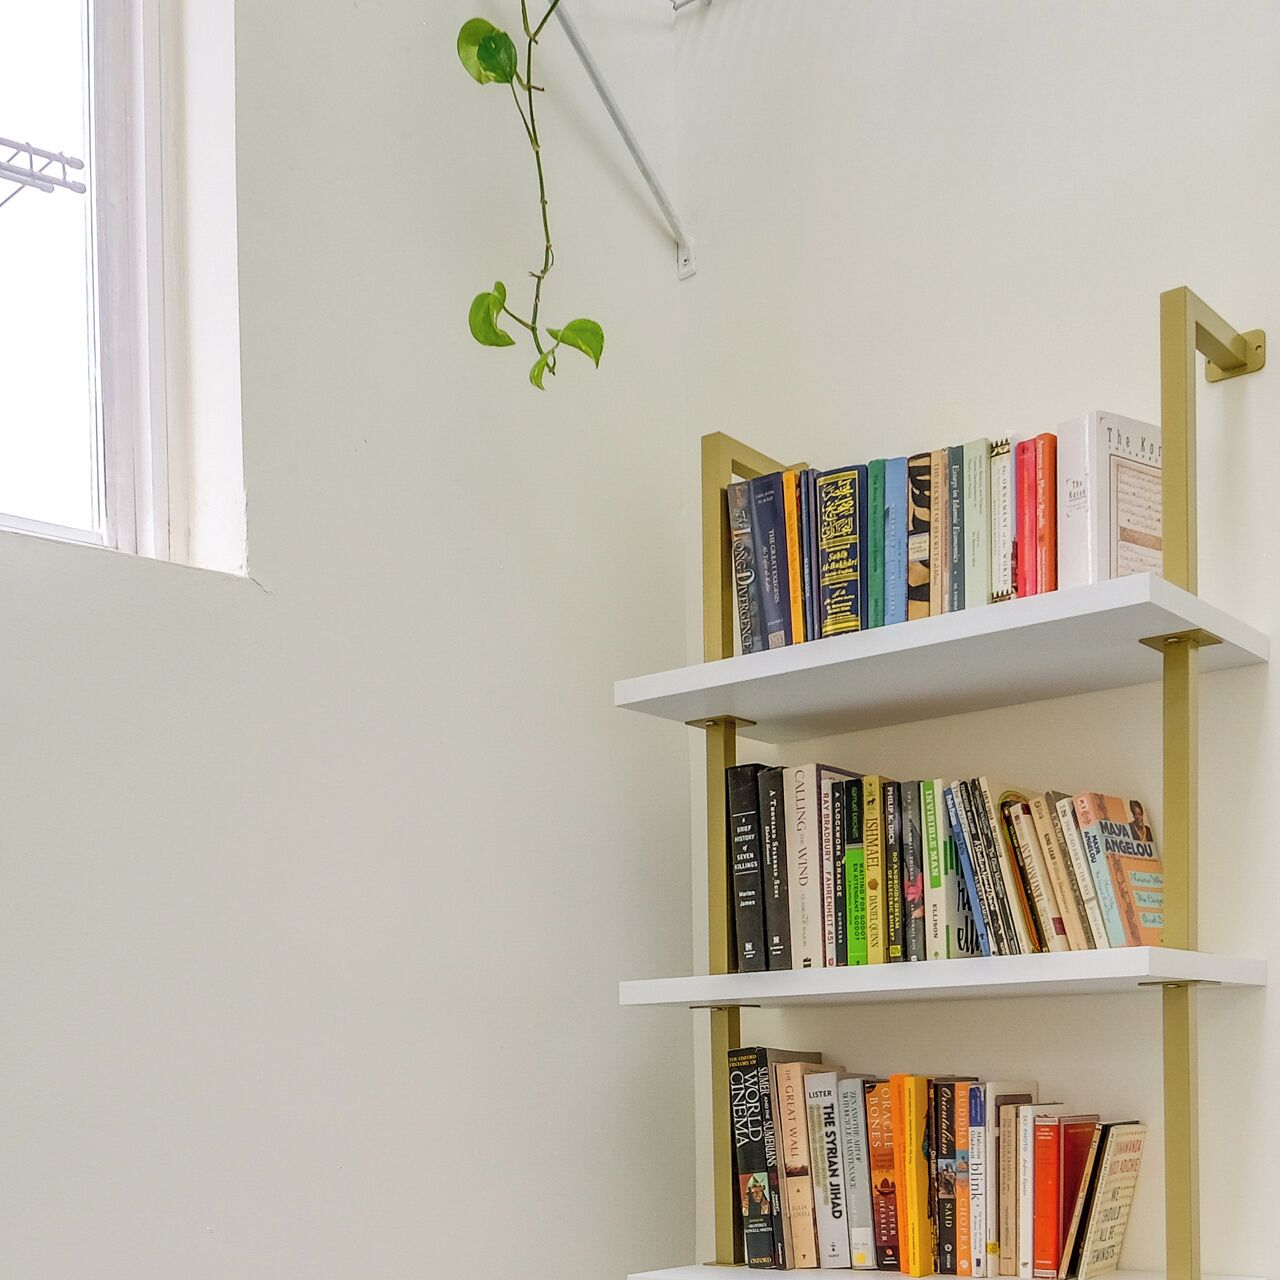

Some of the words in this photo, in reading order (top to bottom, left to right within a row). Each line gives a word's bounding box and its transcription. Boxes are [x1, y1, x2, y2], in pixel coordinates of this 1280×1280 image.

[823, 810, 831, 862] BRADBURY
[866, 818, 879, 870] ISHMAEL
[1084, 831, 1096, 863] ANGELOU
[1092, 835, 1100, 855] MAYA
[1099, 821, 1130, 838] MAYA
[1104, 839, 1153, 857] ANGELOU
[730, 1070, 749, 1147] CINEMA
[745, 1072, 763, 1142] WORLD
[809, 1090, 832, 1098] LISTER
[823, 1103, 835, 1128] THE
[870, 1098, 881, 1147] BONES
[881, 1088, 894, 1149] ORACLE
[941, 1087, 954, 1154] Orientalism
[826, 1132, 838, 1178] SYRIAN
[971, 1163, 983, 1200] blink
[829, 1182, 842, 1219] JIHAD
[945, 1203, 953, 1228] SAID
